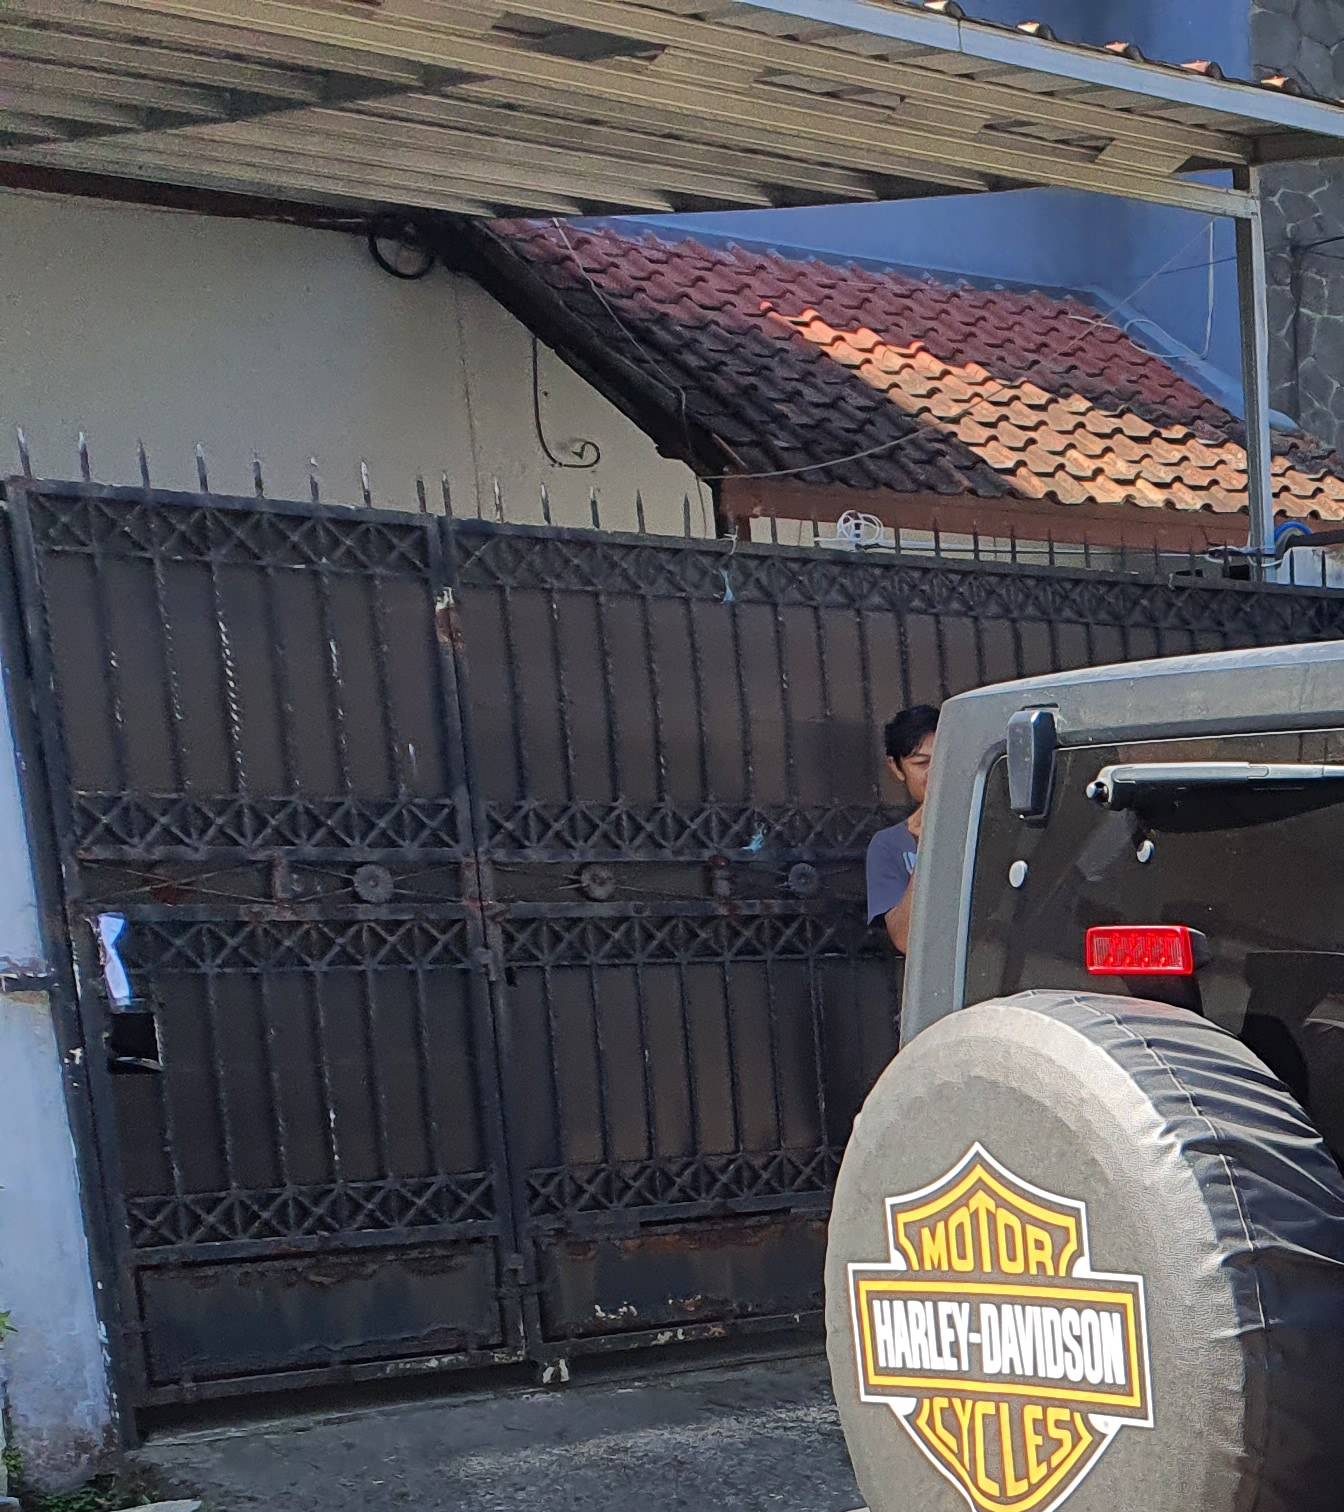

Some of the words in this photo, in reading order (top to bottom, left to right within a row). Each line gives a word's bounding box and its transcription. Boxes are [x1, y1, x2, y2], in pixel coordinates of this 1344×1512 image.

[920, 1189, 1055, 1276] MOTOR
[873, 1299, 1126, 1385] HARLEY-DAVIDSON
[933, 1397, 1072, 1498] CYCLES
